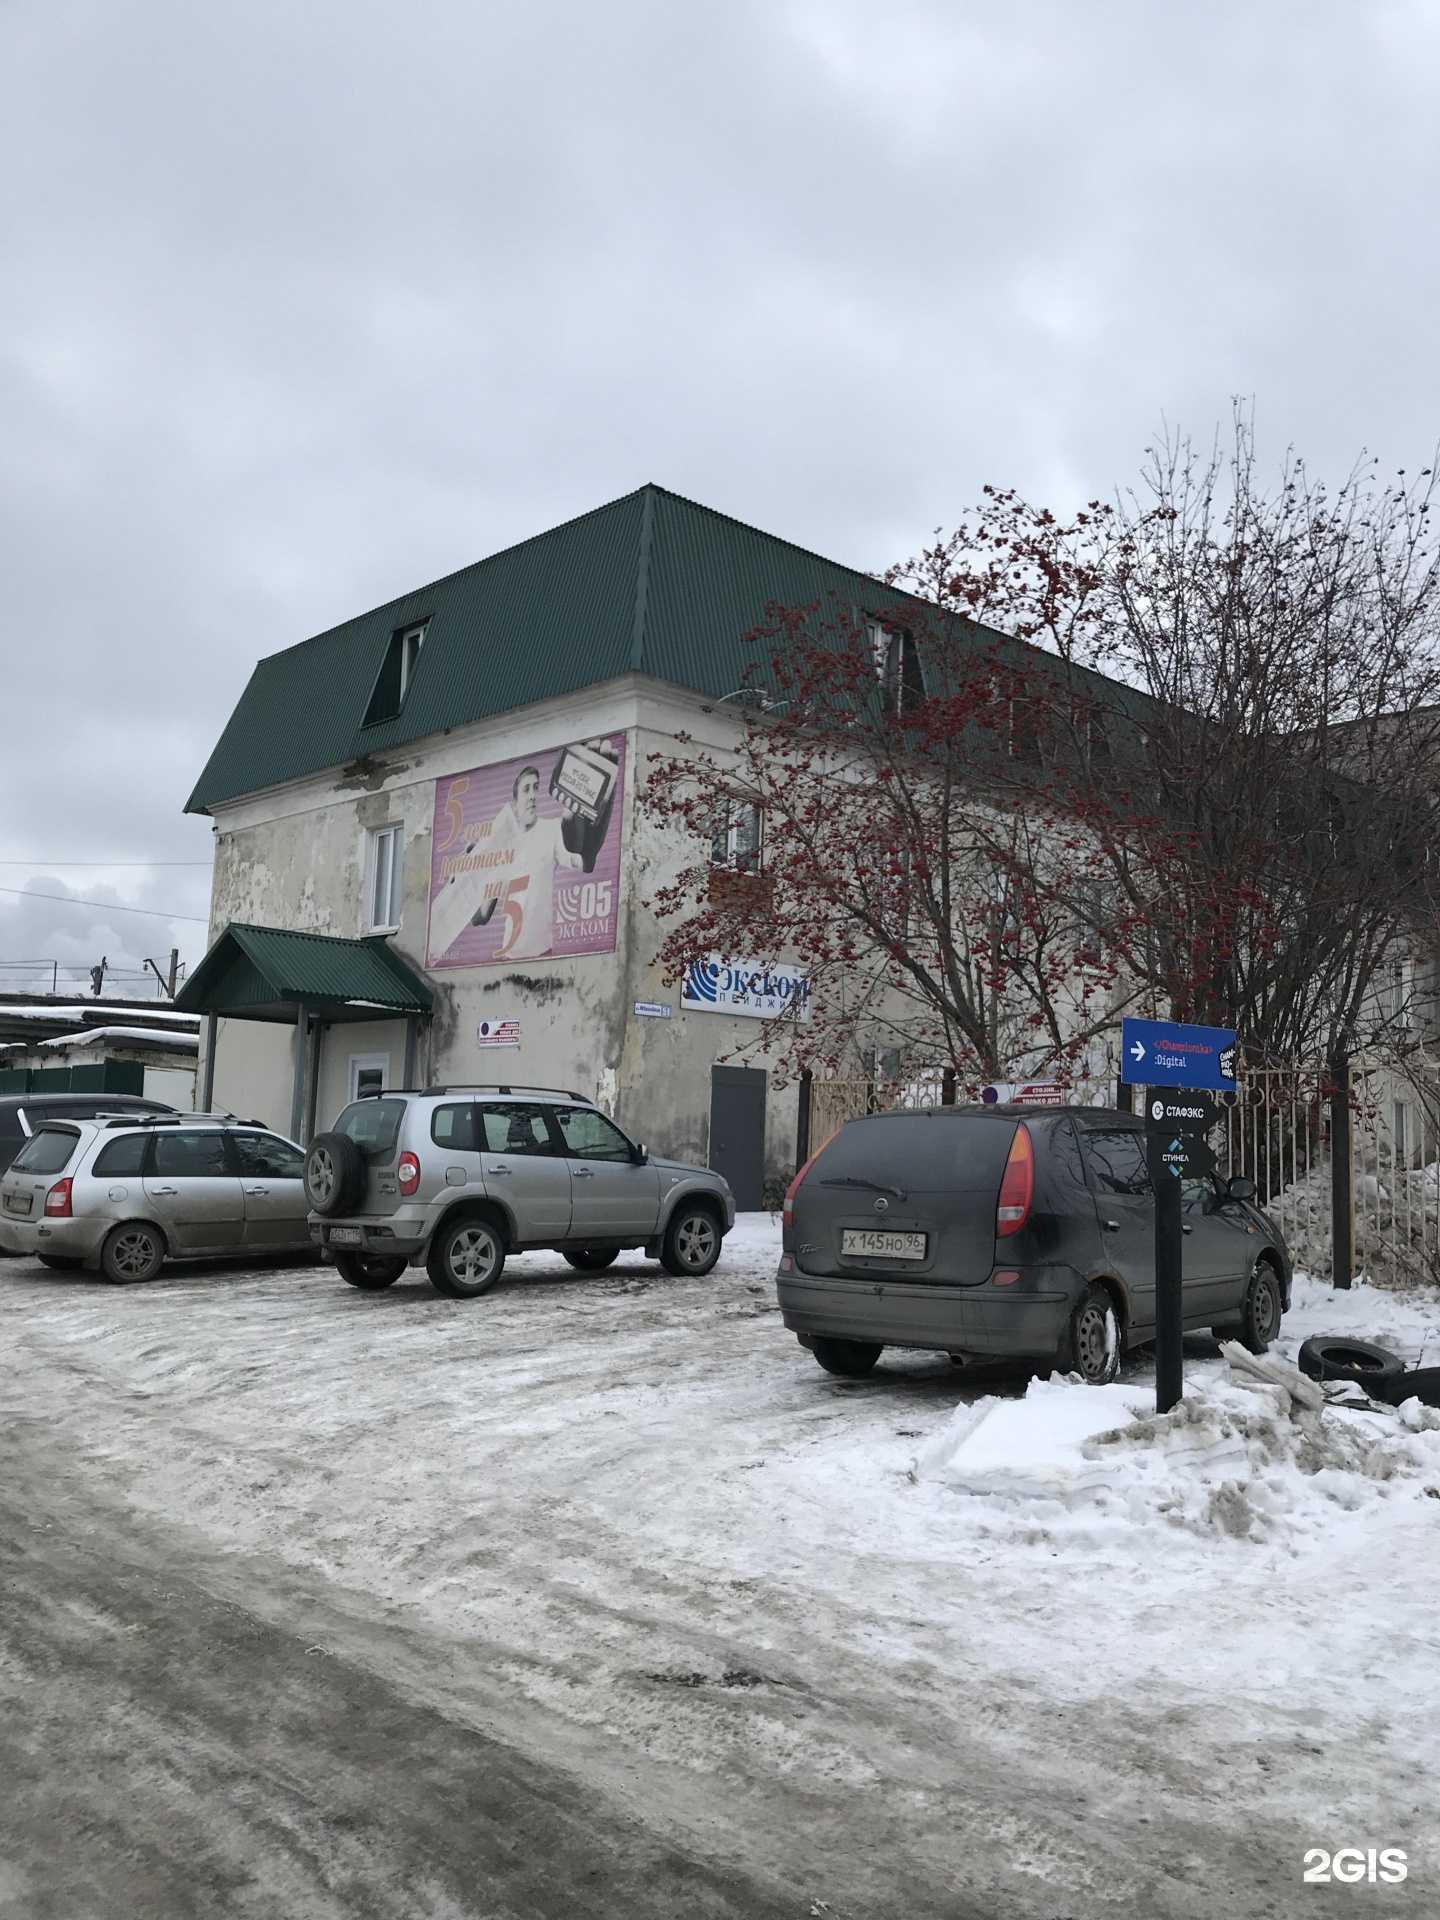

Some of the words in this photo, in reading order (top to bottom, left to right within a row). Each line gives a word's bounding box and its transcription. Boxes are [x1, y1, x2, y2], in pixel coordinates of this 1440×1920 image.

[438, 776, 471, 853] 5
[493, 873, 530, 959] 5
[1166, 1106, 1204, 1119] СТАФЭКС
[1162, 1154, 1189, 1162] СТИНЕЛ
